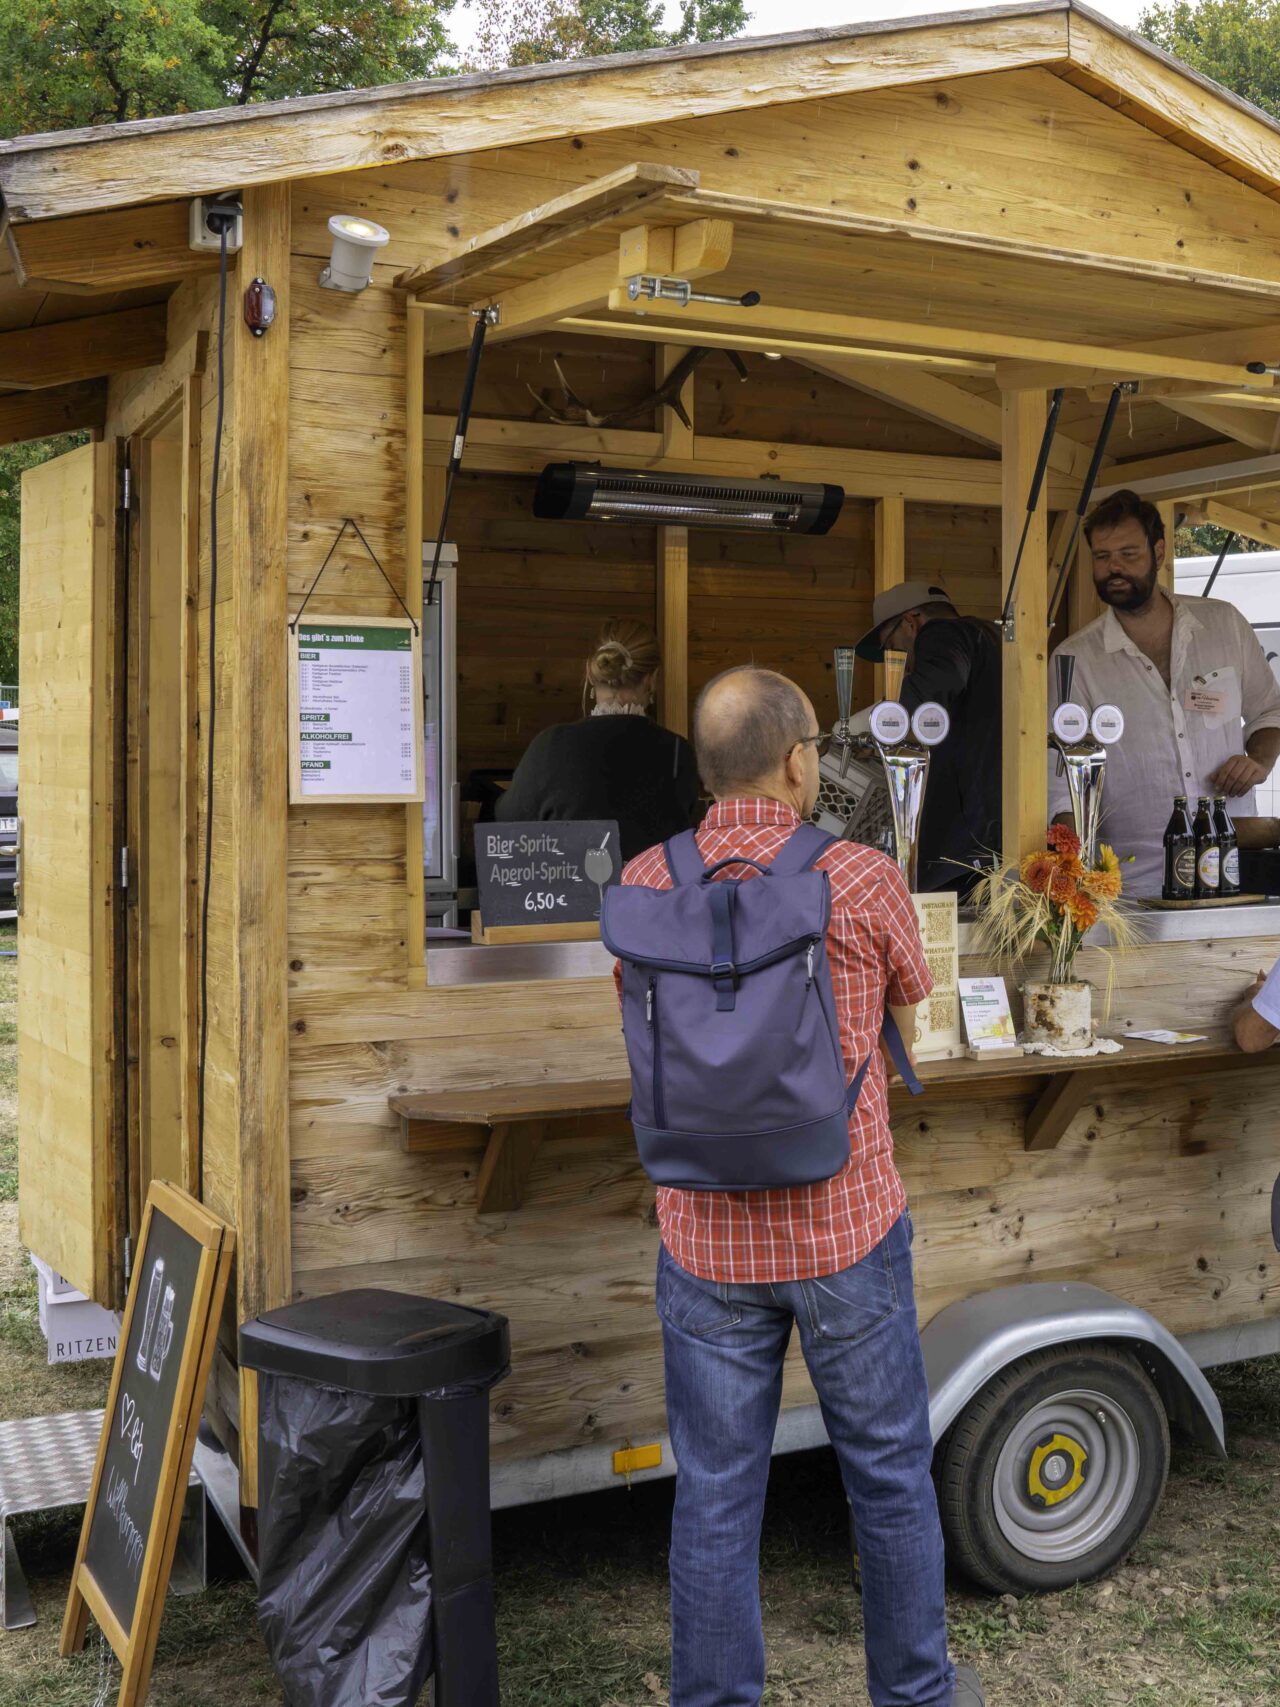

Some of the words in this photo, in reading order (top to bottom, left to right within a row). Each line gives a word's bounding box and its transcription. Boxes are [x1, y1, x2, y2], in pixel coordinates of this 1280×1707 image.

[487, 834, 560, 857] Bier-Spritz
[490, 861, 580, 886] Aperol-Spritz
[921, 902, 955, 910] INSTAGRAM
[928, 991, 956, 999] ACEBOOK
[56, 1336, 116, 1356] RITZEN
